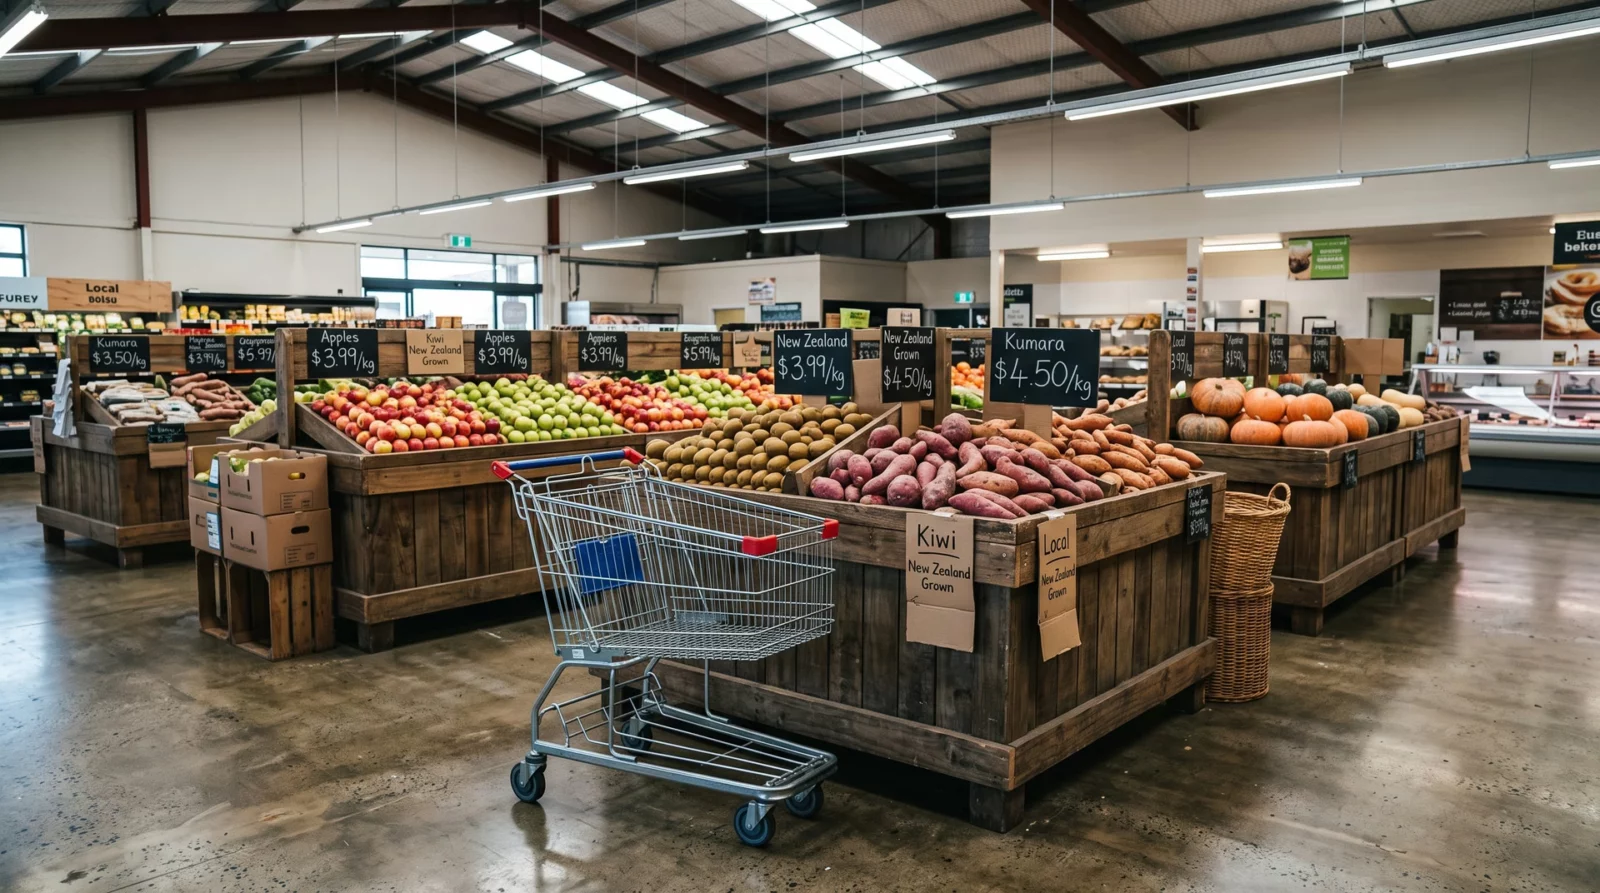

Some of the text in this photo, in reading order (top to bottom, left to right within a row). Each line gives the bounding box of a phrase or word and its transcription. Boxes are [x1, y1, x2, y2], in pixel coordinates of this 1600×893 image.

[1576, 230, 1600, 240] Eus
[85, 283, 119, 293] Local
[97, 337, 138, 348] Kumara
[320, 330, 360, 347] Apples
[426, 333, 444, 344] Kiwi
[484, 331, 515, 347] Apples
[777, 334, 801, 348] New
[803, 332, 848, 348] Zealand
[884, 331, 902, 344] New
[1005, 331, 1065, 351] Kumara
[1172, 334, 1186, 347] Local
[238, 347, 276, 363] $5.99/
[409, 345, 462, 355] New Zealand
[478, 346, 528, 370] $3.99/kg
[581, 346, 624, 368] $3.99/kg
[683, 346, 721, 366] $5.99/kg
[893, 346, 920, 361] Grown
[92, 351, 147, 369] $3.50/kg
[311, 347, 375, 375] $3.99/kg
[422, 356, 449, 366] Grown
[1171, 352, 1193, 377] 3.99/kg
[883, 365, 933, 397] $4.50/kg
[994, 357, 1091, 401] $4.50/kg
[917, 524, 956, 550] Kiwi
[1043, 528, 1070, 556] Local
[908, 559, 971, 580] New Zealand
[1041, 564, 1076, 587] New Zealand
[921, 577, 954, 593] Grown
[1048, 587, 1067, 601] Grown
